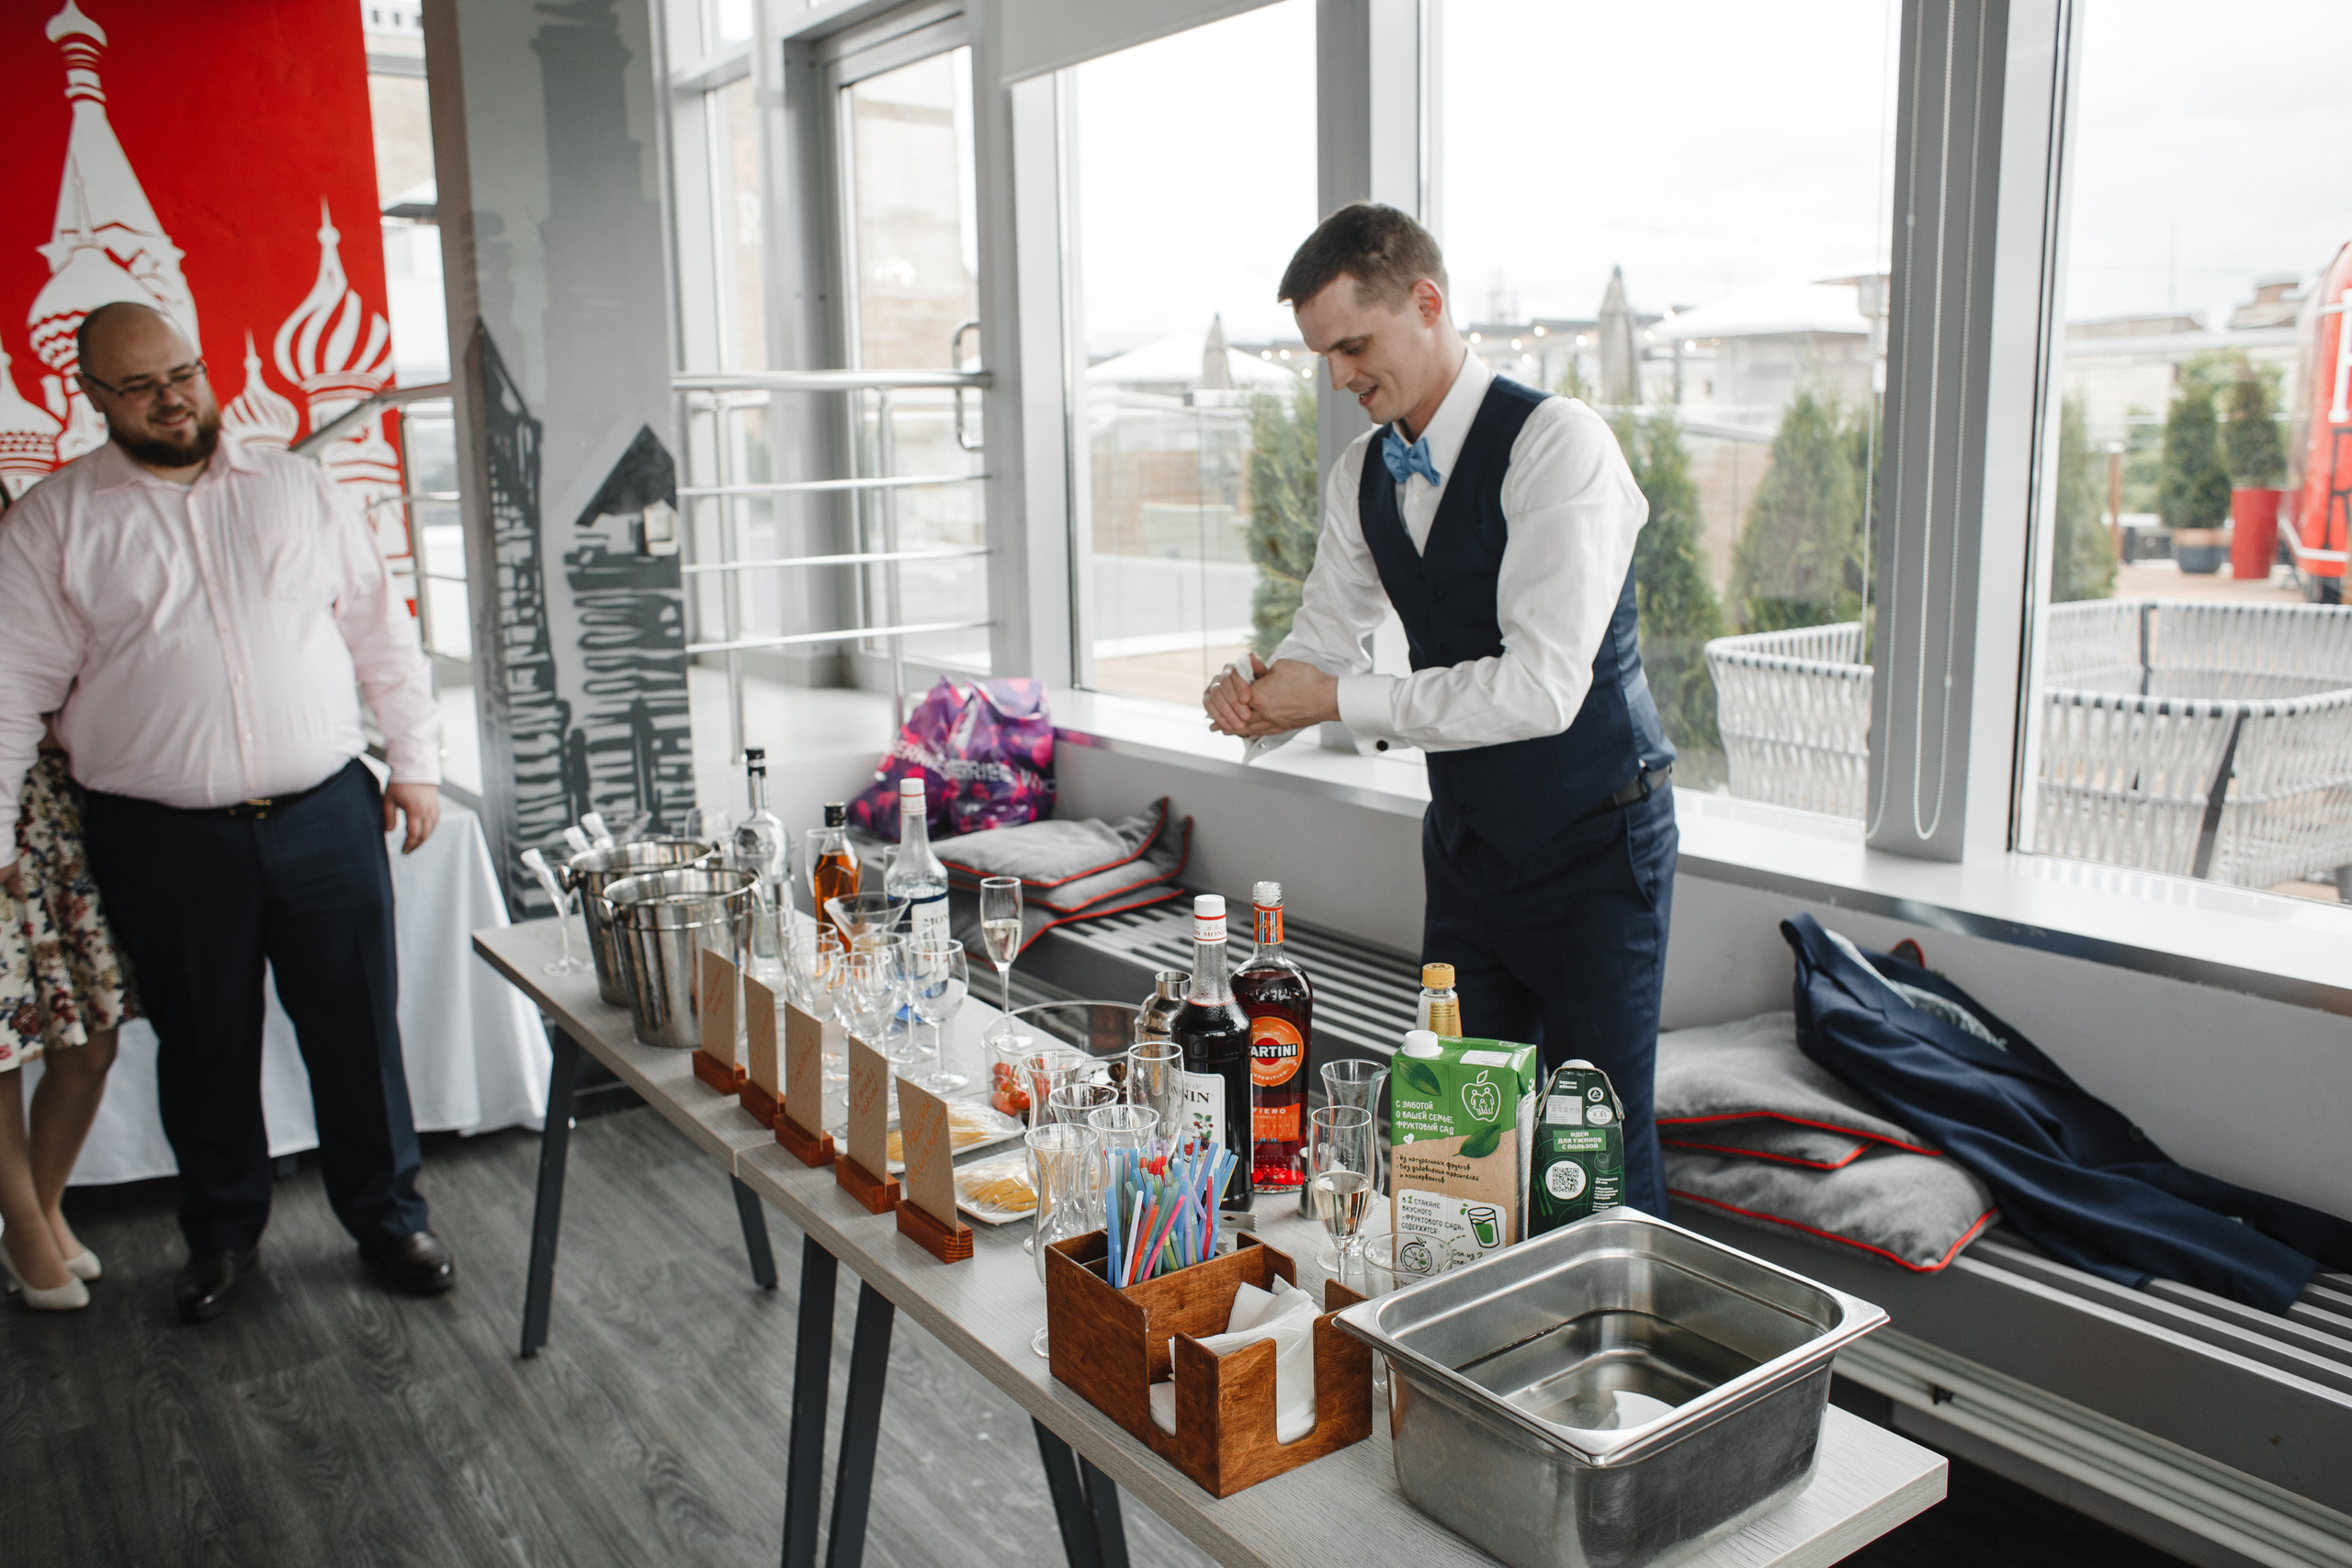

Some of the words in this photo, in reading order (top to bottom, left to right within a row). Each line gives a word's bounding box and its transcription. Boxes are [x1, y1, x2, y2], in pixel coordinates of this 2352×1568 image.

[1250, 1043, 1296, 1058] ARTINI
[1402, 1100, 1433, 1111] ЗАБОТОЙ
[1402, 1111, 1427, 1120] ВАШЕЙ
[1429, 1113, 1454, 1124] СЕМЬЕ.
[1396, 1121, 1438, 1132] ФРУКТОВЫЙ
[1440, 1125, 1454, 1135] САД
[1408, 1195, 1413, 1203] 1
[1414, 1198, 1441, 1209] СТАКАНЕ
[1402, 1205, 1432, 1216] ВКУСНОГО
[1402, 1213, 1443, 1227] «ФРУКТОВОГО
[1466, 1253, 1475, 1261] из
